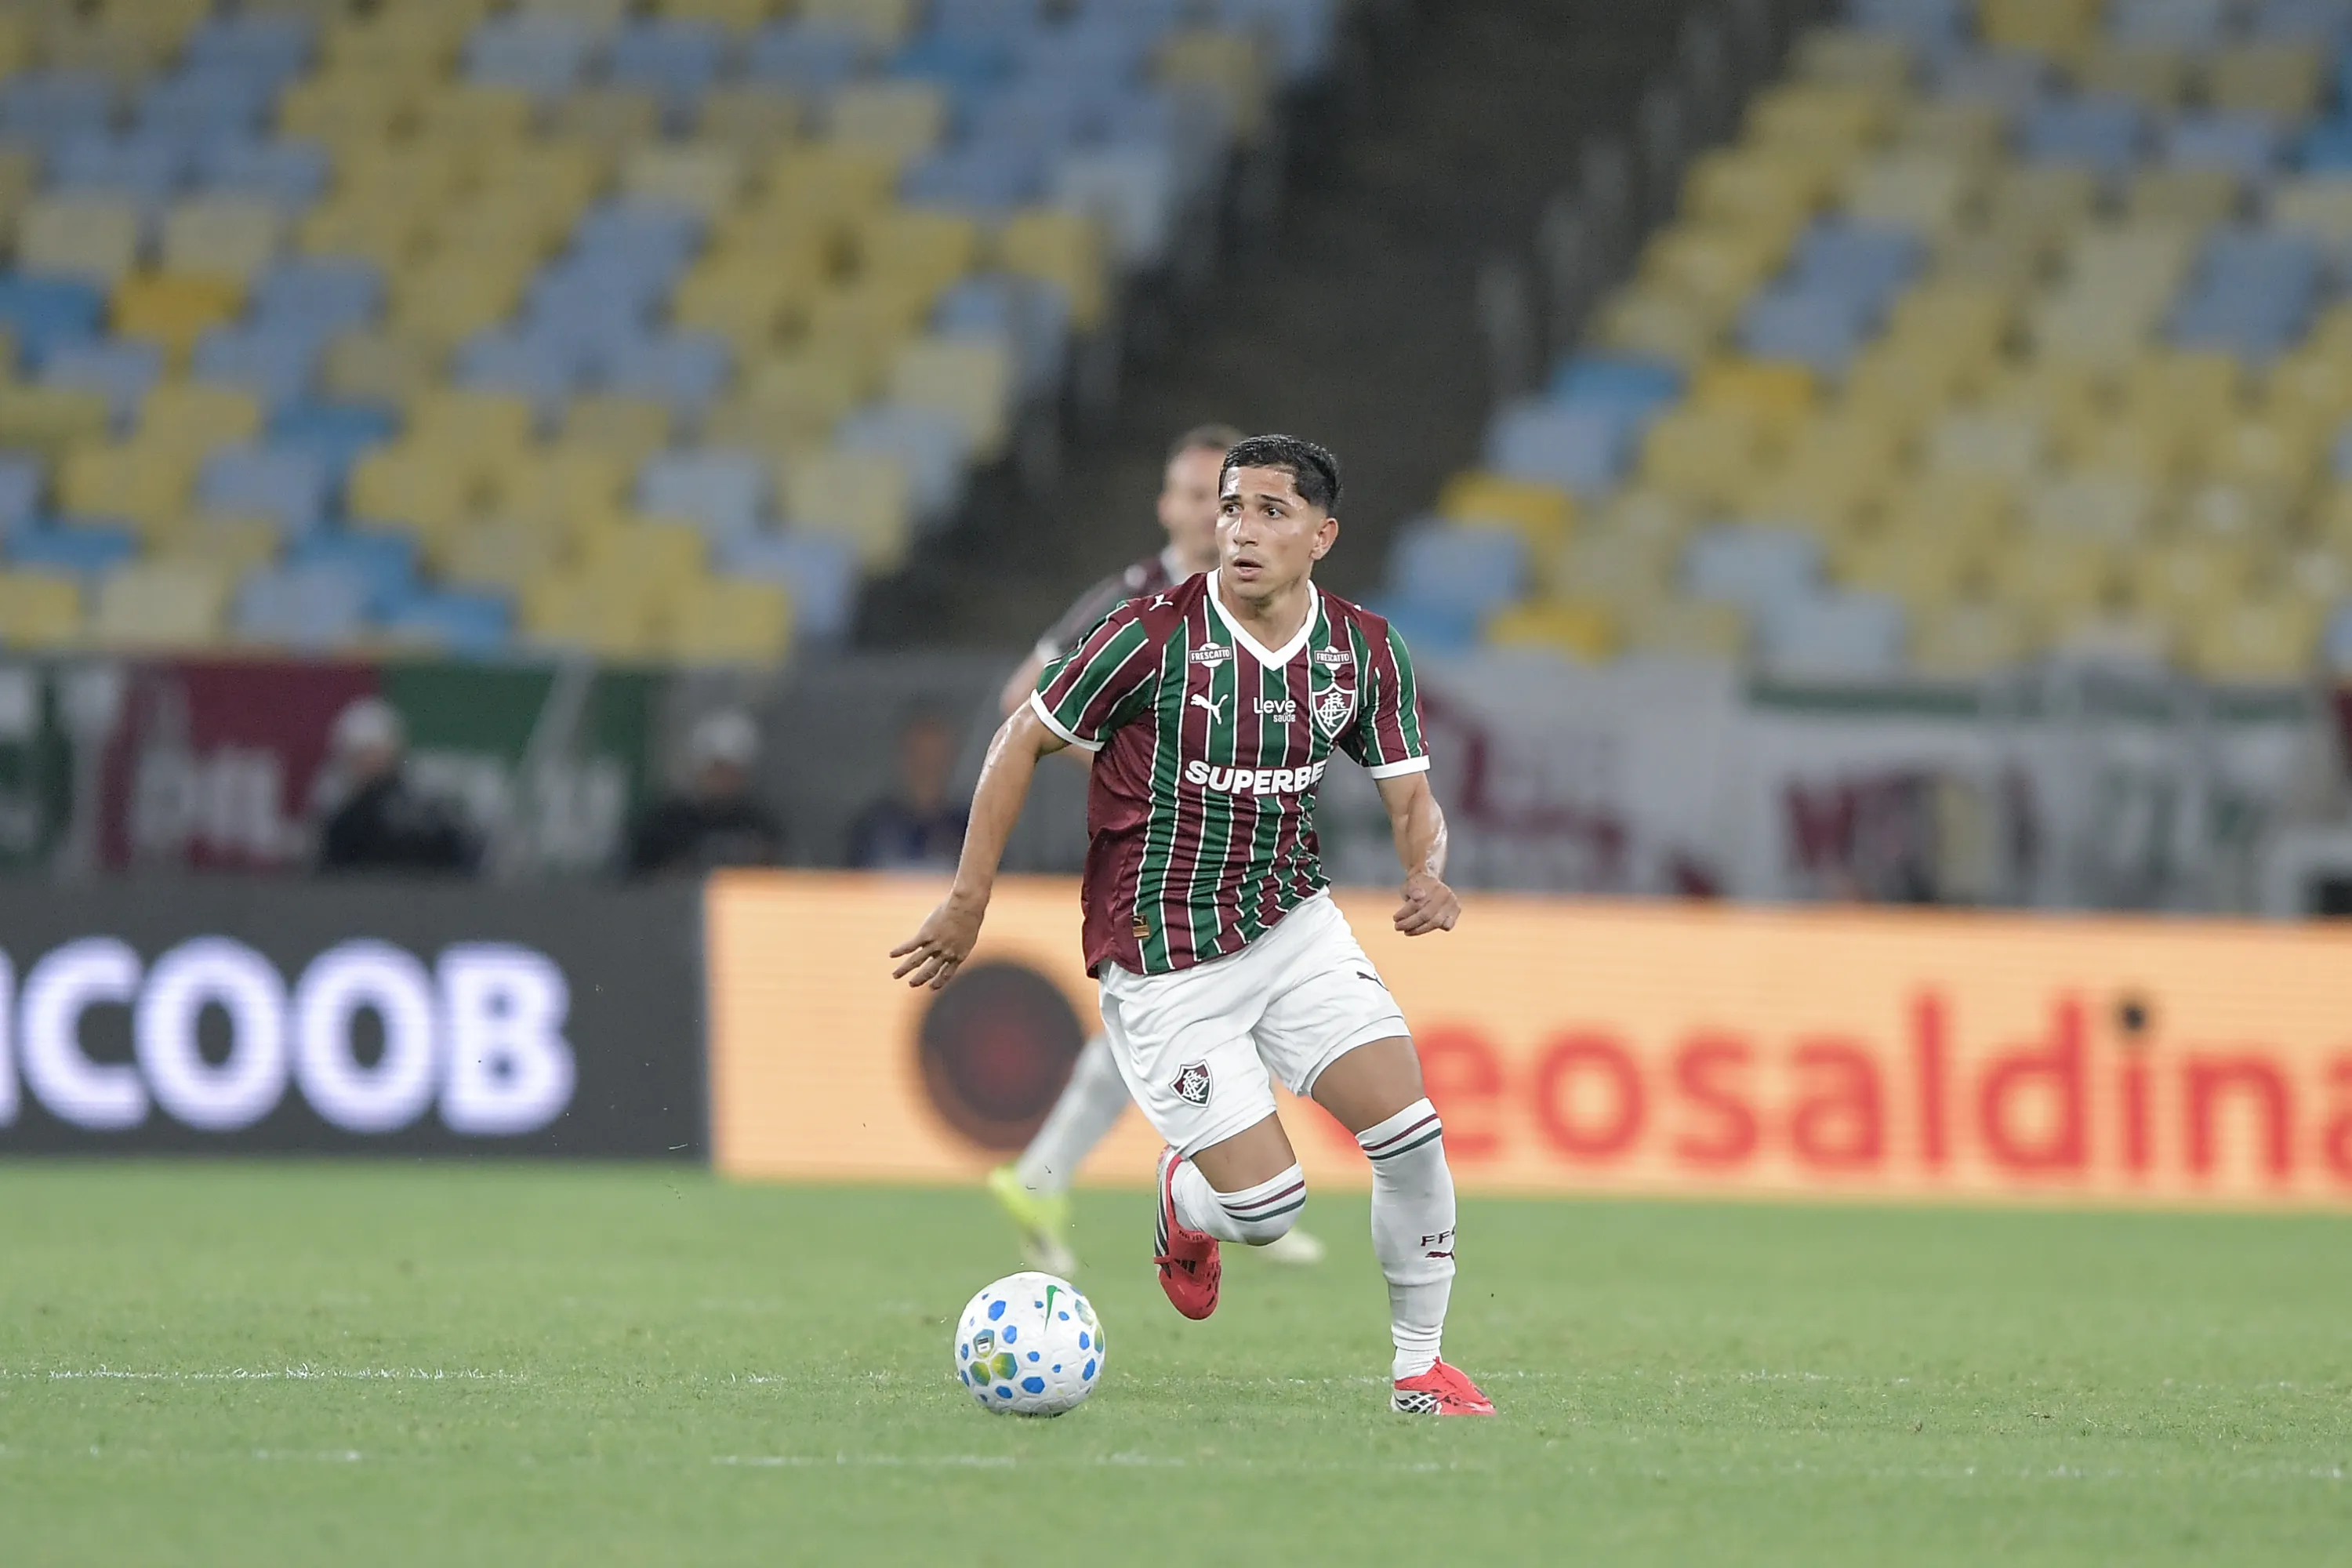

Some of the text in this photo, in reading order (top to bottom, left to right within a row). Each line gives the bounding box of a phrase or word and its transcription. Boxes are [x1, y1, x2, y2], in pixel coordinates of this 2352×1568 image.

[1191, 648, 1231, 661] FRESCATTO
[1253, 697, 1296, 714] Leve
[1325, 989, 2352, 1181] eosaldin
[1420, 1228, 1455, 1247] FF
